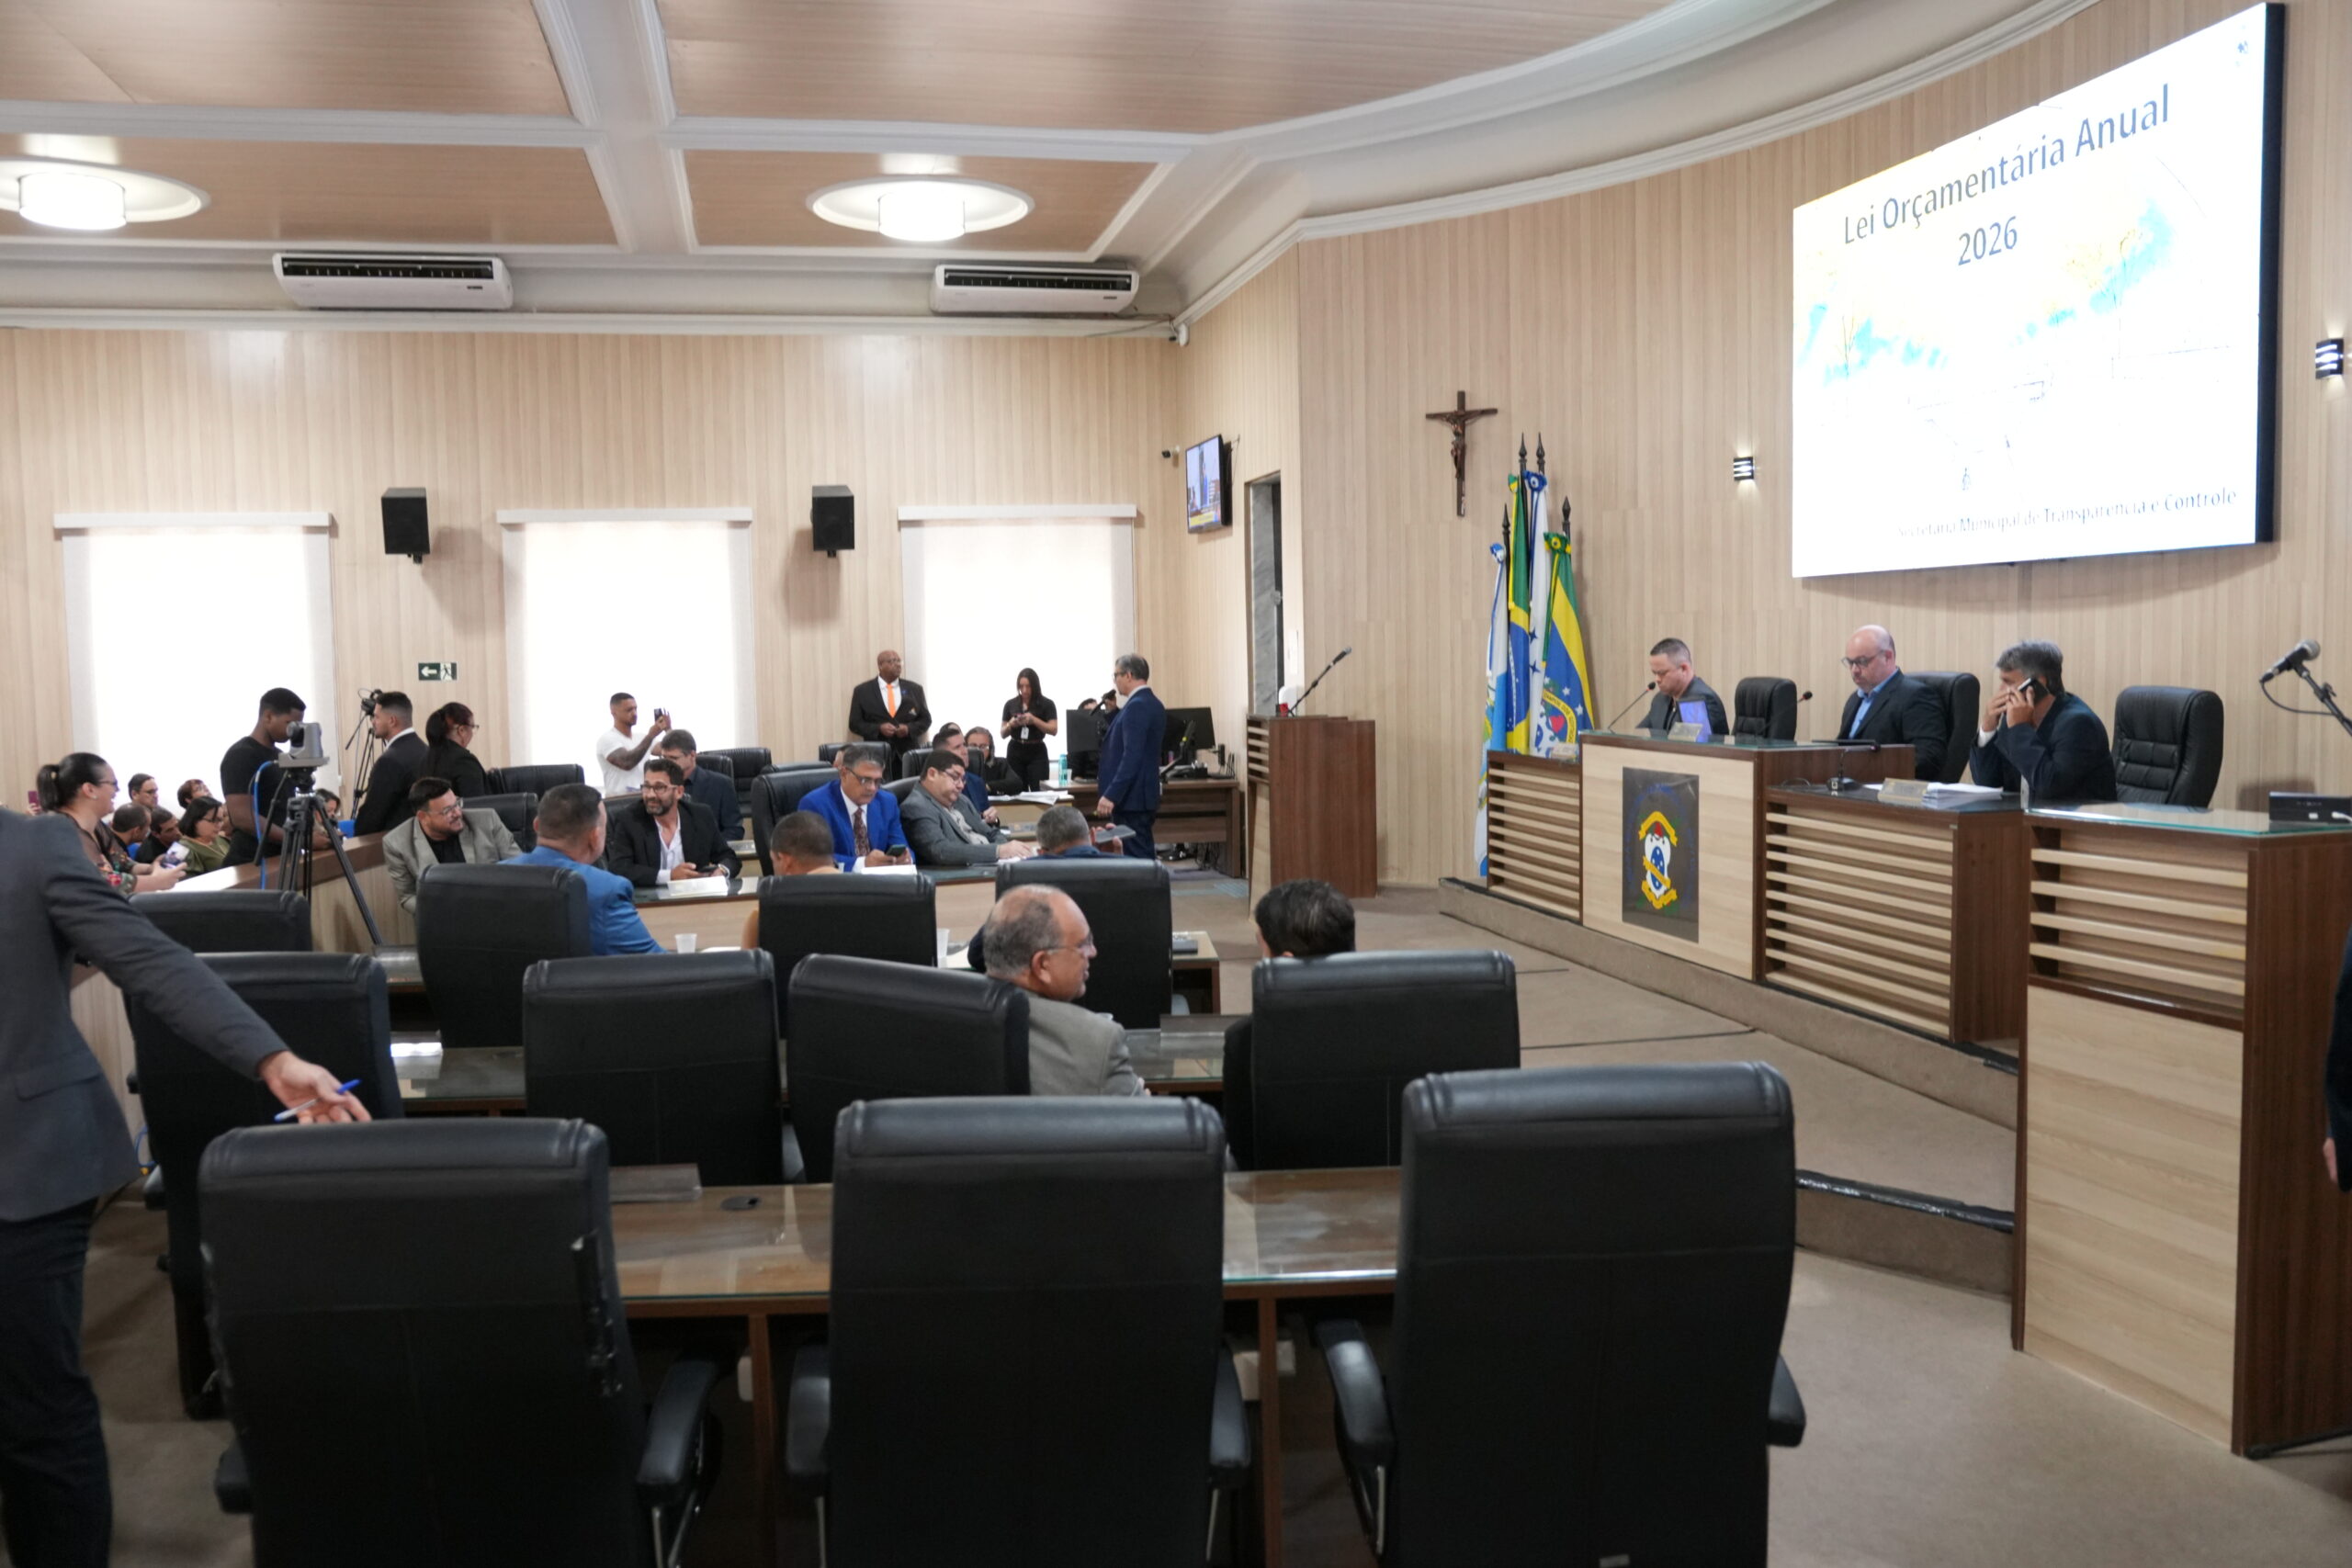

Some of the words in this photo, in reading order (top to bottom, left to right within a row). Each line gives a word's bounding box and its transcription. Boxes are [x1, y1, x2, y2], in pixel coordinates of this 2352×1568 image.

[1844, 204, 1875, 244] Lei
[1883, 134, 2065, 230] Orçamentária
[2075, 83, 2169, 158] Anual
[1957, 216, 2018, 266] 2026
[1960, 512, 2020, 533] Municipal
[2024, 510, 2040, 525] de
[2151, 501, 2159, 513] e
[2165, 487, 2237, 512] Controle
